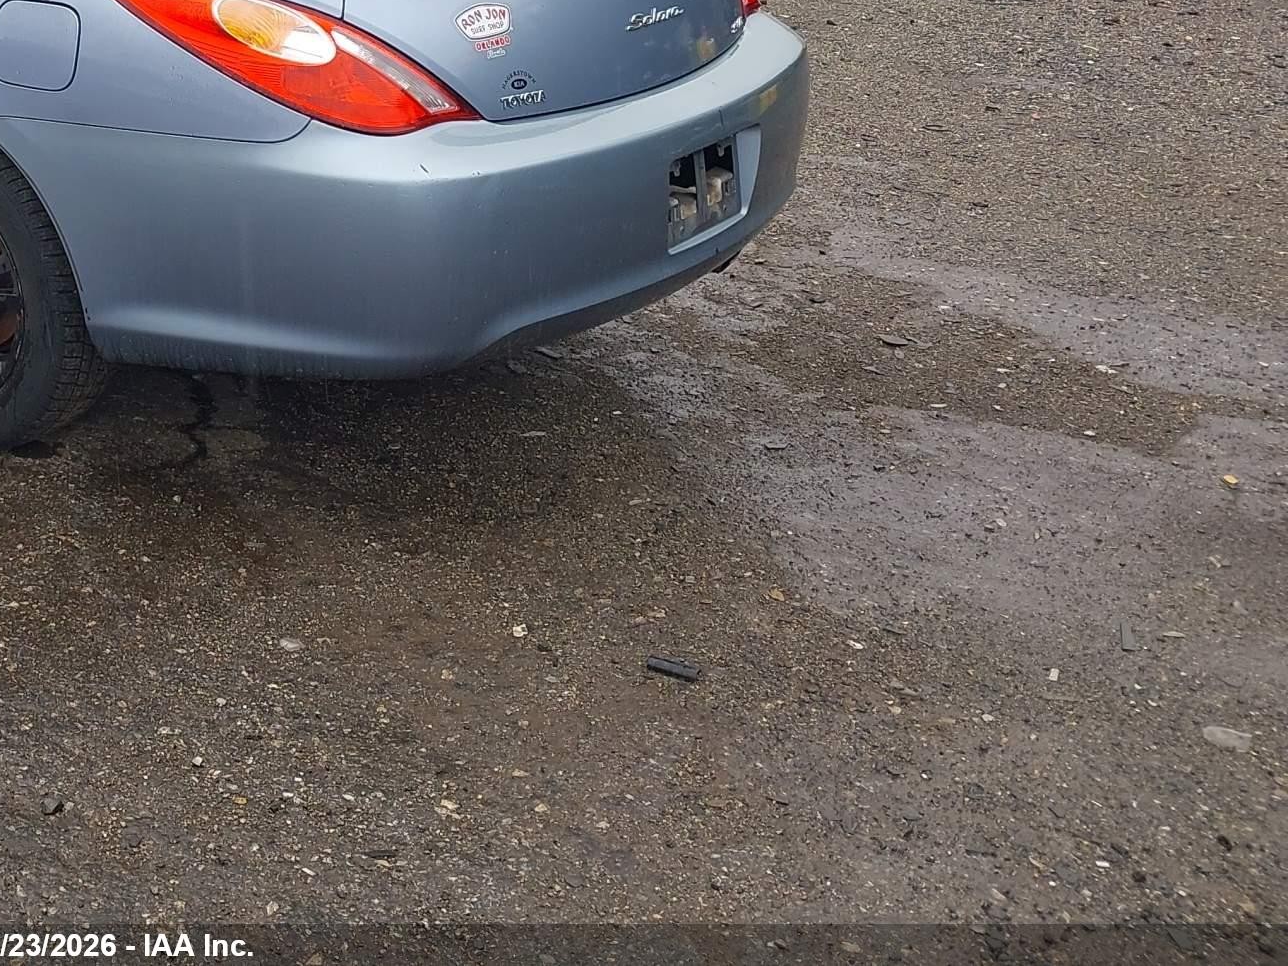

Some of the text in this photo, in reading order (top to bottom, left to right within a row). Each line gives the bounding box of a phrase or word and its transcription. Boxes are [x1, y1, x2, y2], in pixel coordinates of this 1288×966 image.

[461, 8, 506, 30] RON JON
[470, 21, 504, 34] SURF SHOP
[626, 6, 685, 31] Solara
[476, 36, 510, 51] ORLANDO
[502, 69, 536, 90] HAGERSTOWN
[500, 90, 547, 109] TOYOTA
